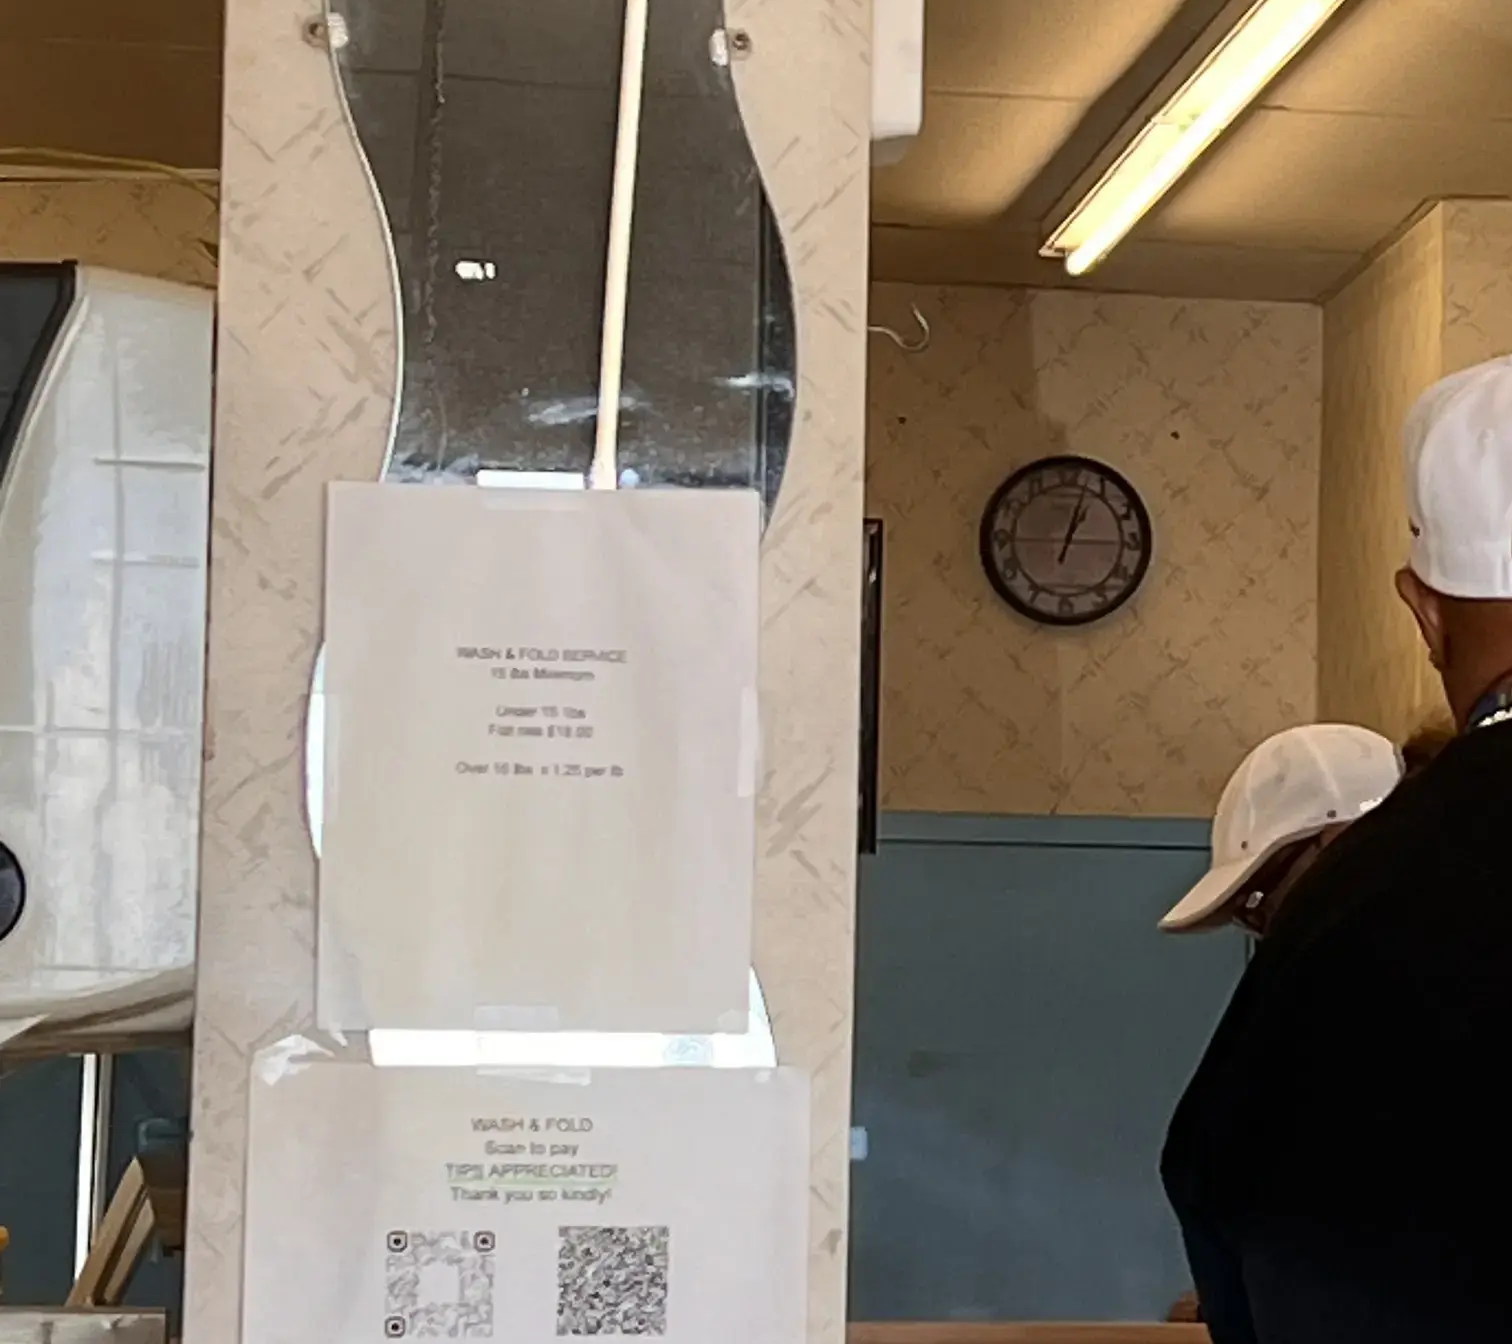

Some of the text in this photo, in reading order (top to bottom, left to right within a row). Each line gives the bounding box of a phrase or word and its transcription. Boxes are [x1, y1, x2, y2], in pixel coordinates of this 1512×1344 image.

[505, 647, 516, 660] &
[518, 646, 559, 662] FOLD
[455, 761, 489, 775] Over
[471, 1117, 594, 1133] WASH & FOLD
[485, 1139, 579, 1158] Scan to pay
[451, 1186, 500, 1202] Thank
[504, 1189, 534, 1205] you
[538, 1191, 558, 1202] so
